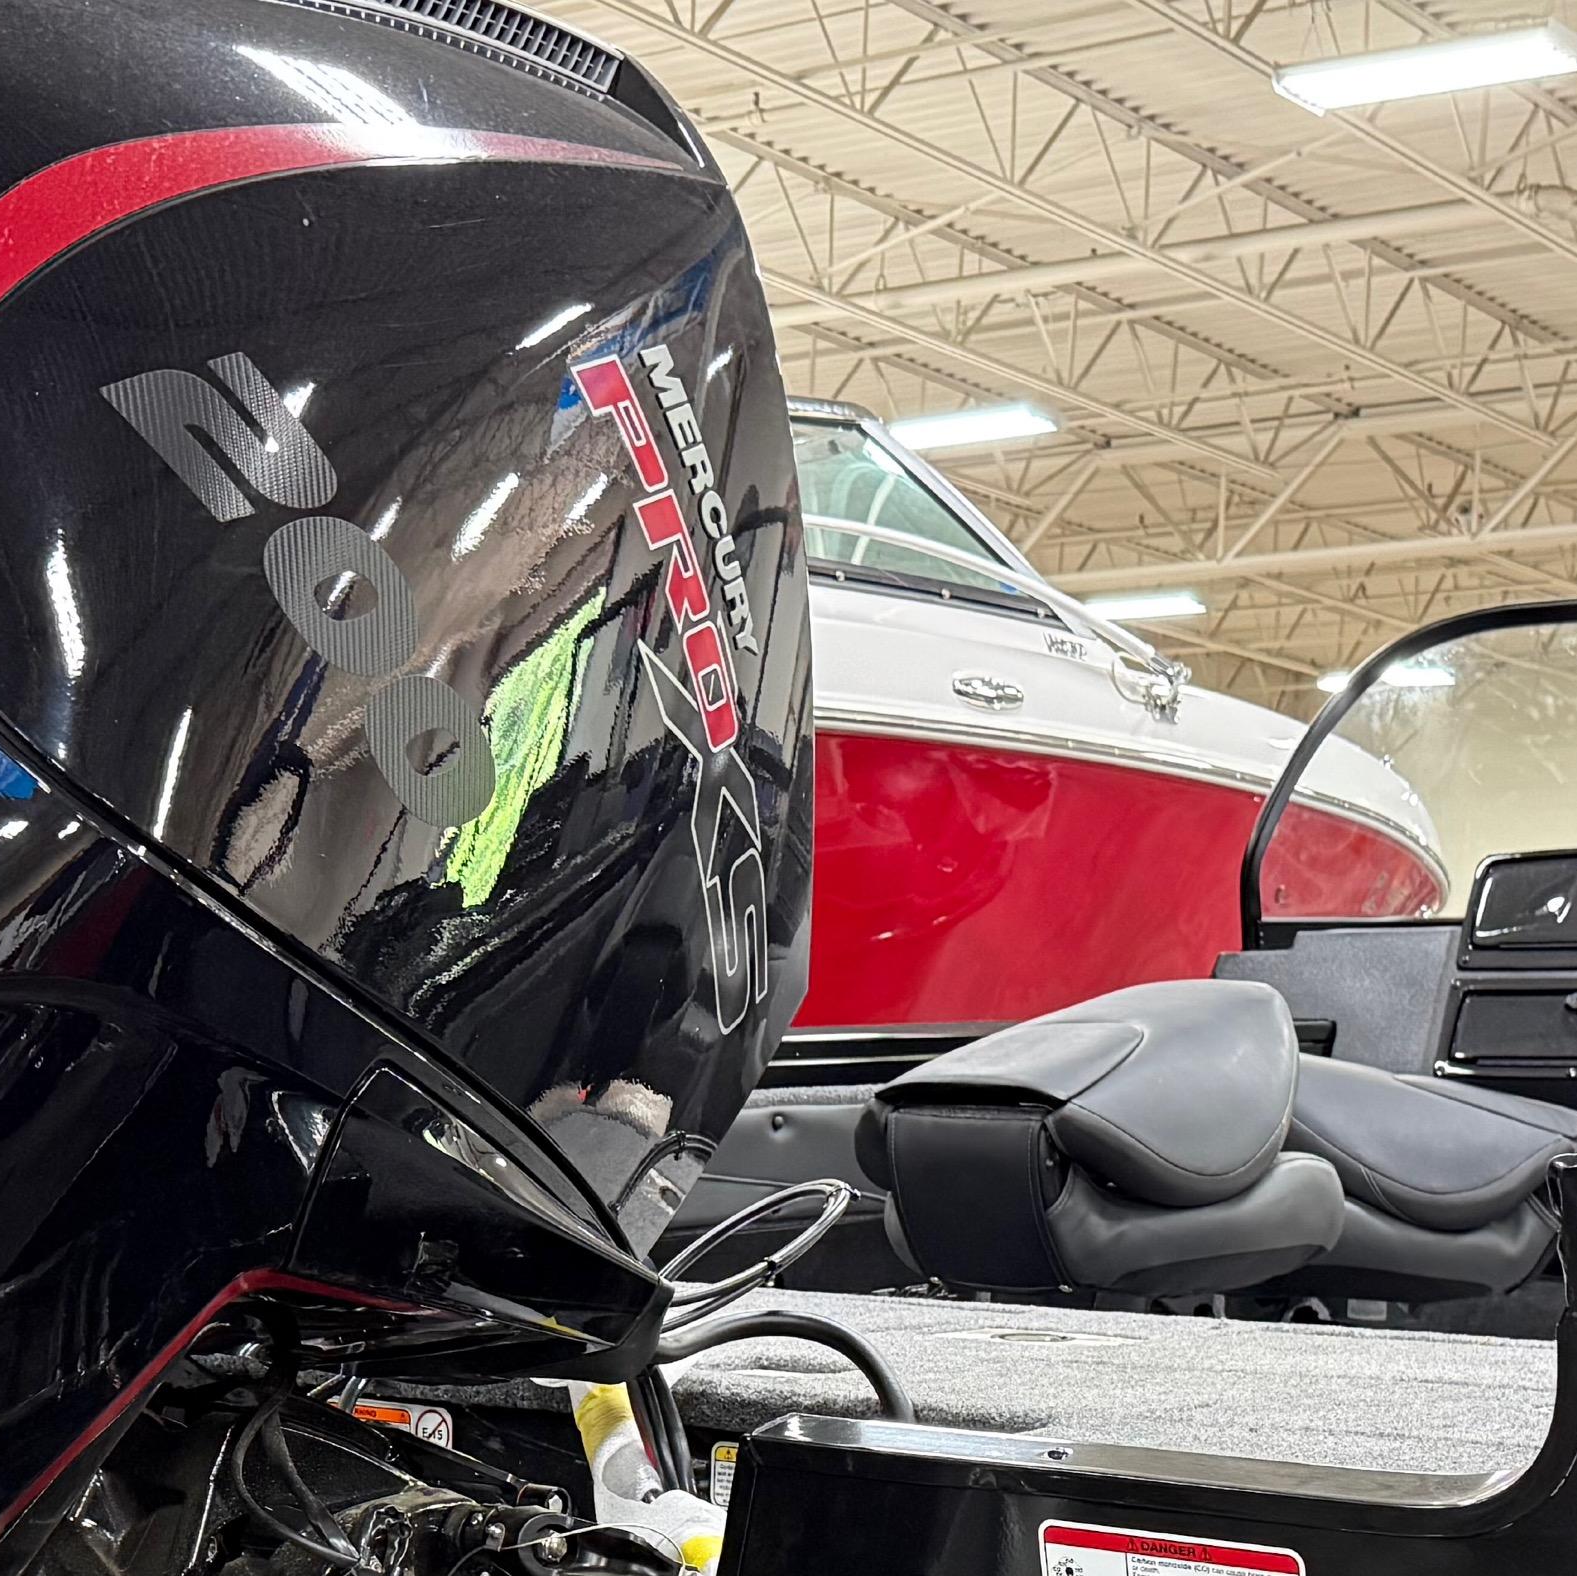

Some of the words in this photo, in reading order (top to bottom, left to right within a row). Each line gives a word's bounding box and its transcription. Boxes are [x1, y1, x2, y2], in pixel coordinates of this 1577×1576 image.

[100, 352, 497, 828] 200
[571, 355, 738, 753] PRO
[639, 345, 757, 656] MERCURY
[1140, 1540, 1196, 1554] DANGER
